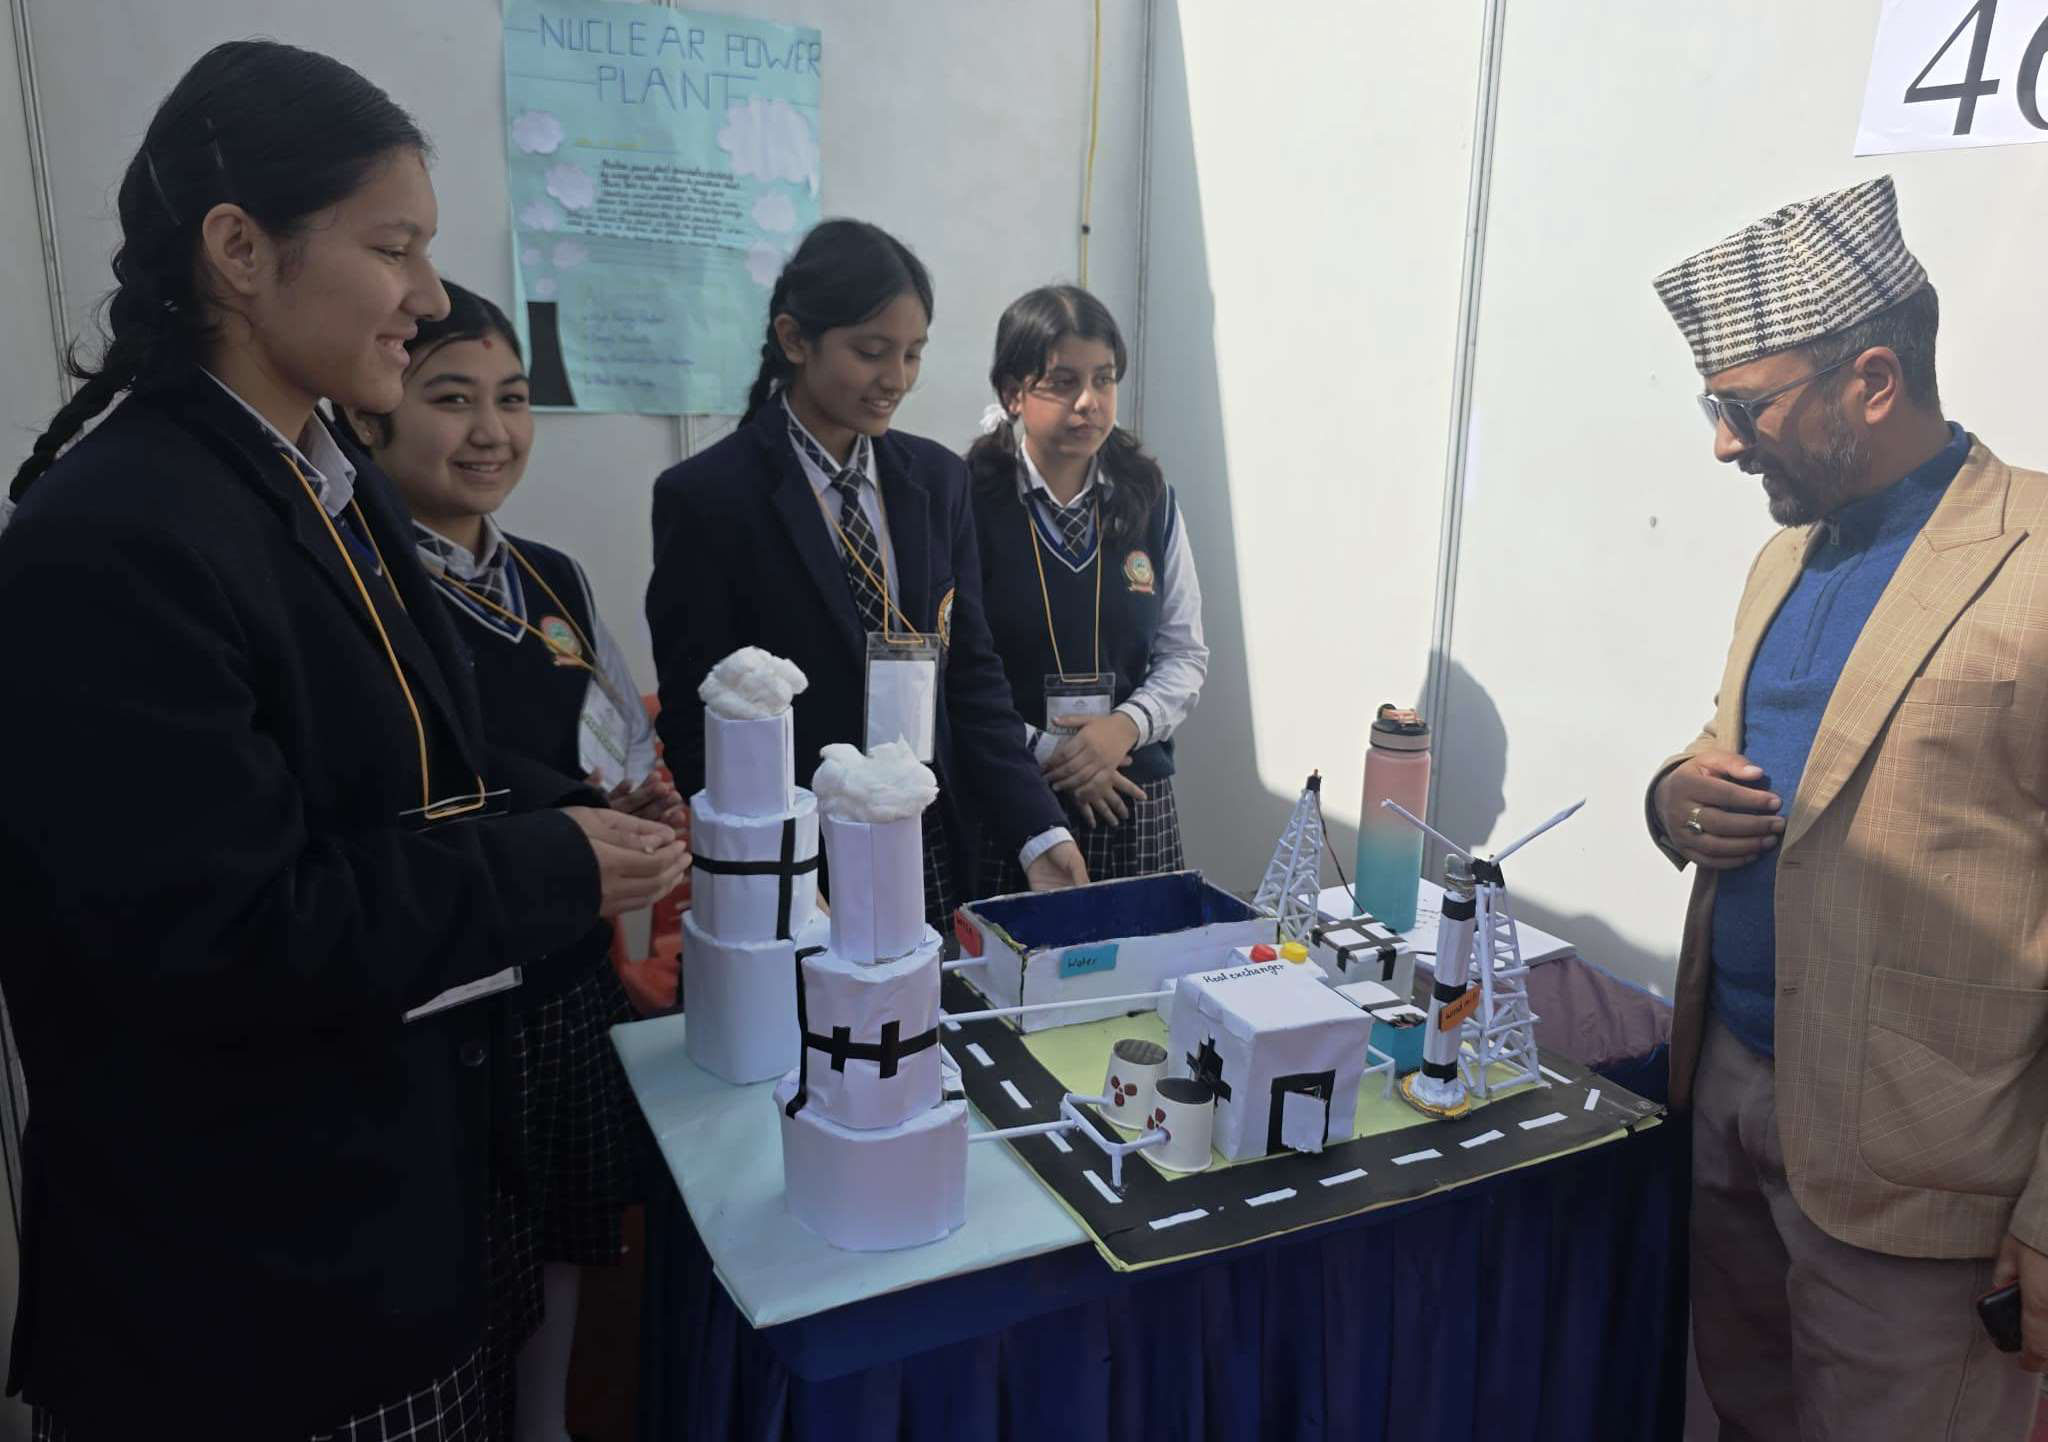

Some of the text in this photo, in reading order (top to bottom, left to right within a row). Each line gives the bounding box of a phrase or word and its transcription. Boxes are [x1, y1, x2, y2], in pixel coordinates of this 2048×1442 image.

[540, 14, 822, 79] NUCLEAR POWER
[597, 64, 758, 112] PLANT
